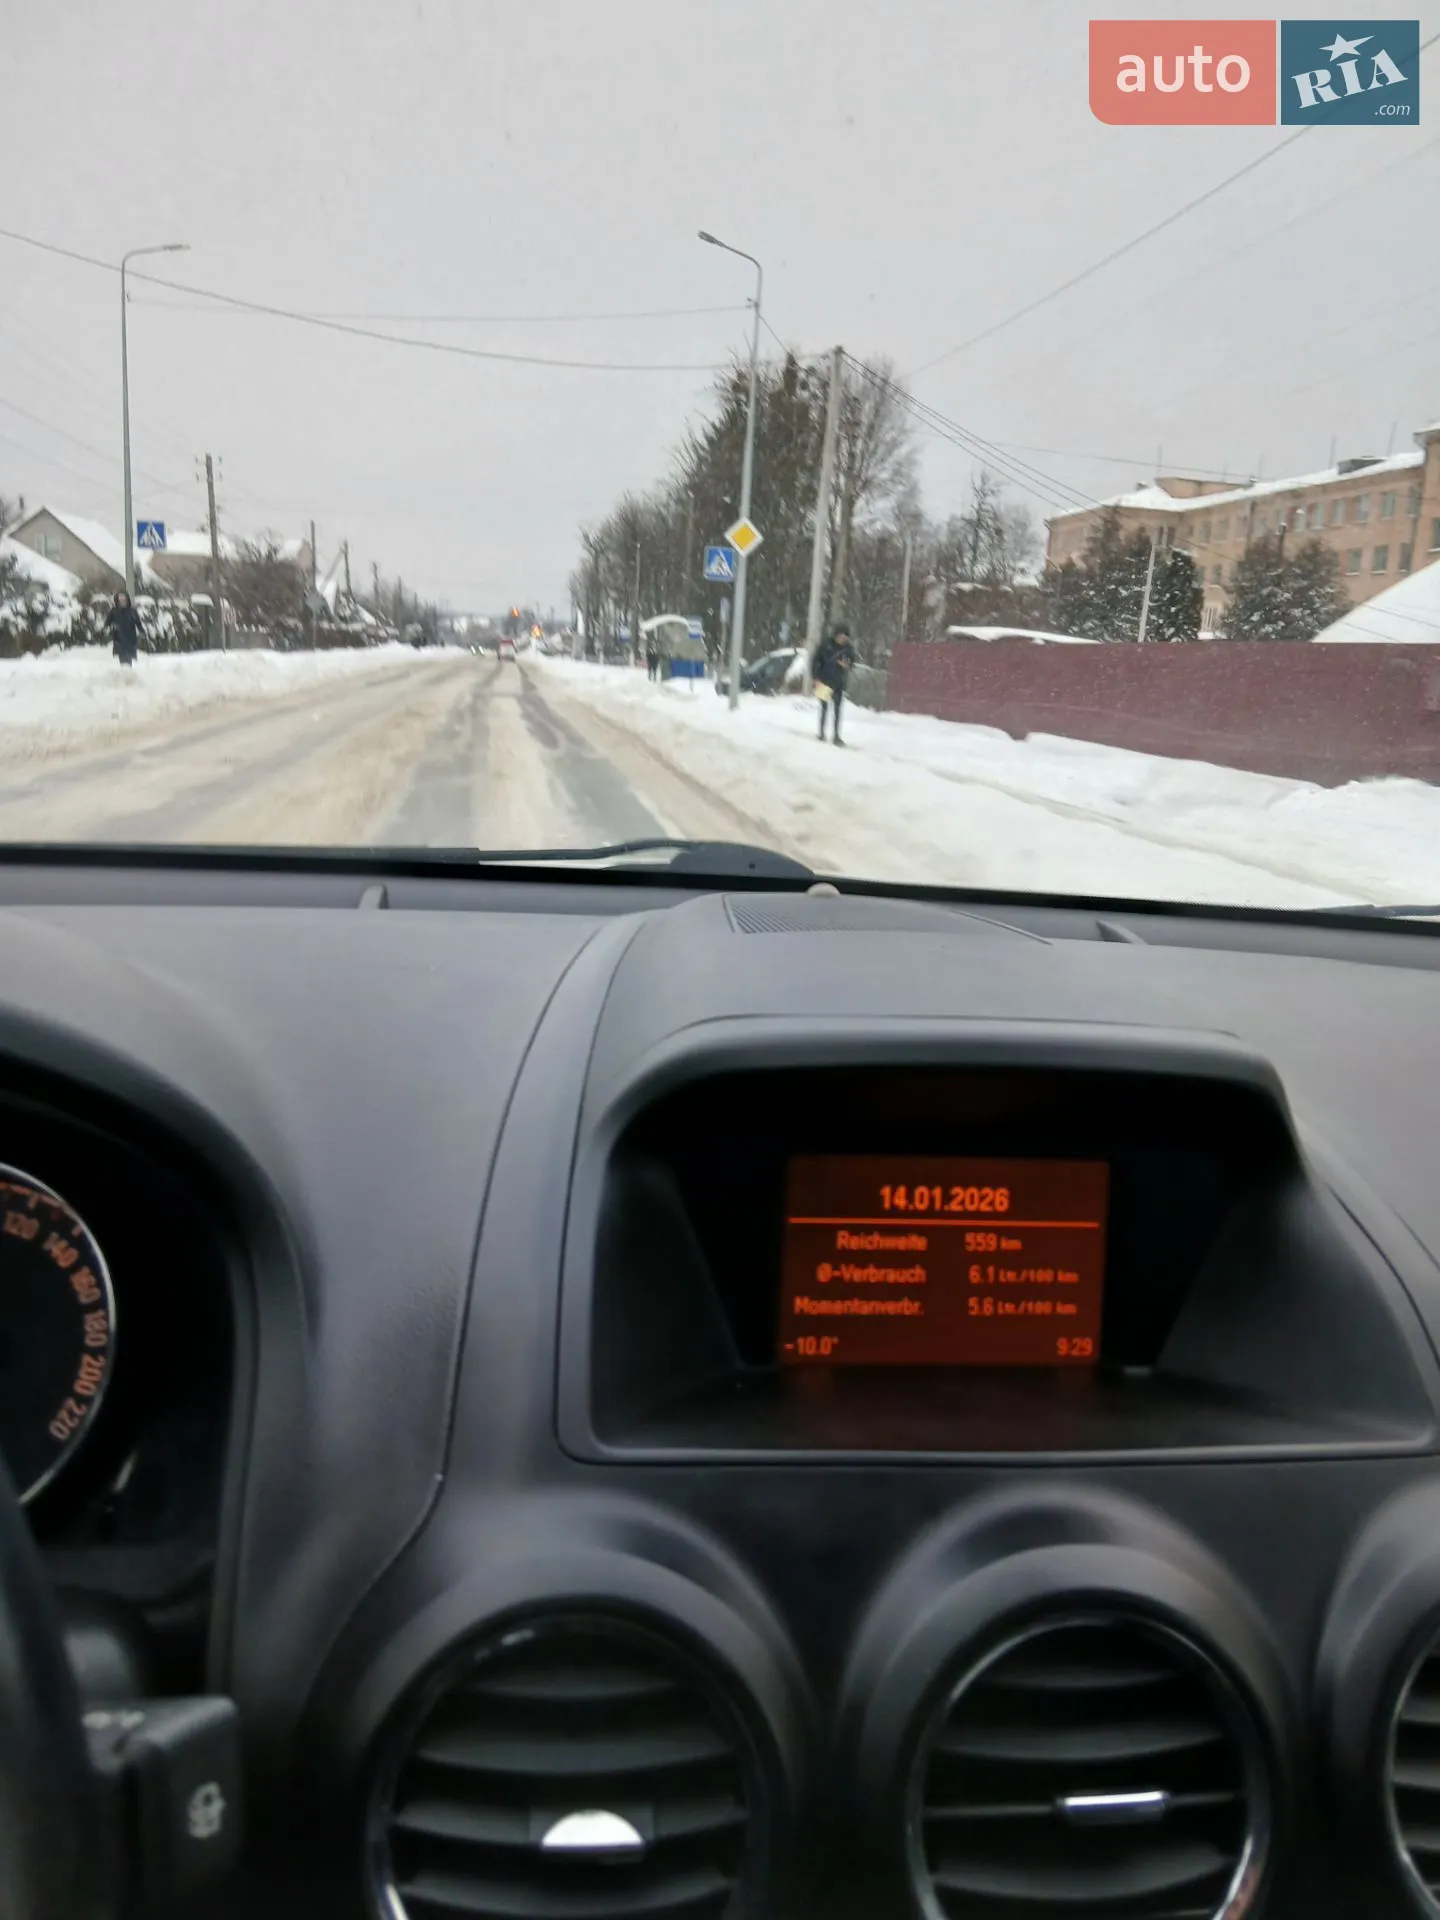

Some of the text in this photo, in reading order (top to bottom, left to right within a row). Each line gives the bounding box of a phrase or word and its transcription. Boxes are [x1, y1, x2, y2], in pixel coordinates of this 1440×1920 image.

[879, 1184, 1010, 1212] 14.01.2026
[836, 1230, 1023, 1252] Reichweite 559 km
[968, 1264, 995, 1284] 6.1
[1057, 1269, 1080, 1284] km
[793, 1295, 925, 1316] Momentanverbr.
[968, 1296, 994, 1316] 5.6
[1055, 1301, 1078, 1315] km
[84, 1309, 108, 1347] 180
[1056, 1336, 1093, 1356] 9:29
[73, 1353, 106, 1396] 200
[49, 1397, 88, 1441] 220
